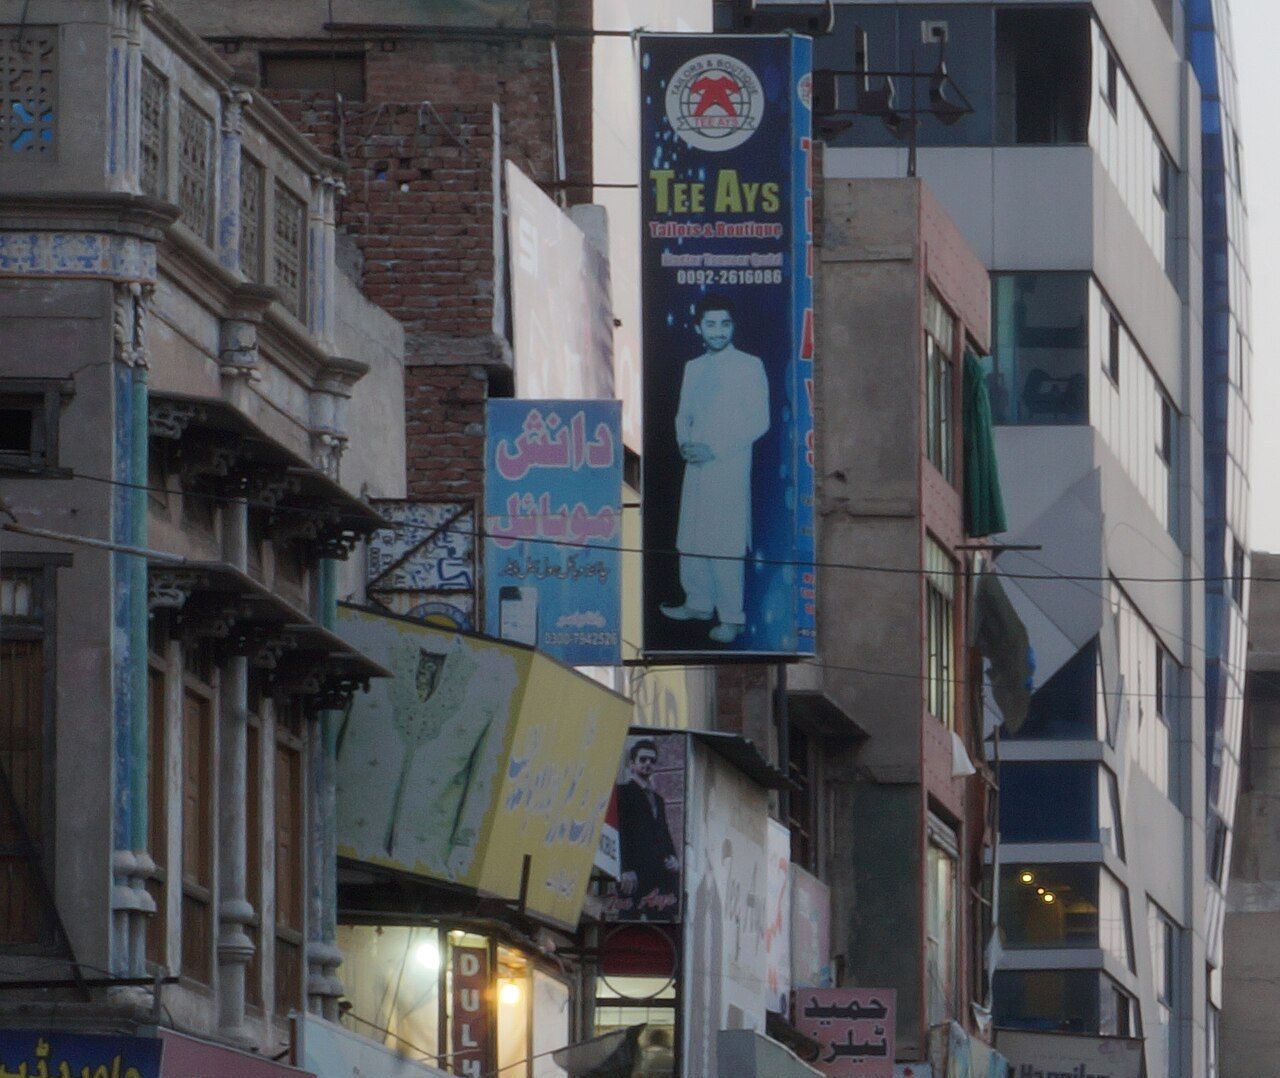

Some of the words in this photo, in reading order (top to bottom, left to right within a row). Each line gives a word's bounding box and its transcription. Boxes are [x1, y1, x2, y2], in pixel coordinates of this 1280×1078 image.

[496, 409, 614, 481] دانش
[490, 492, 616, 549] موبائل
[804, 996, 888, 1026] حمید
